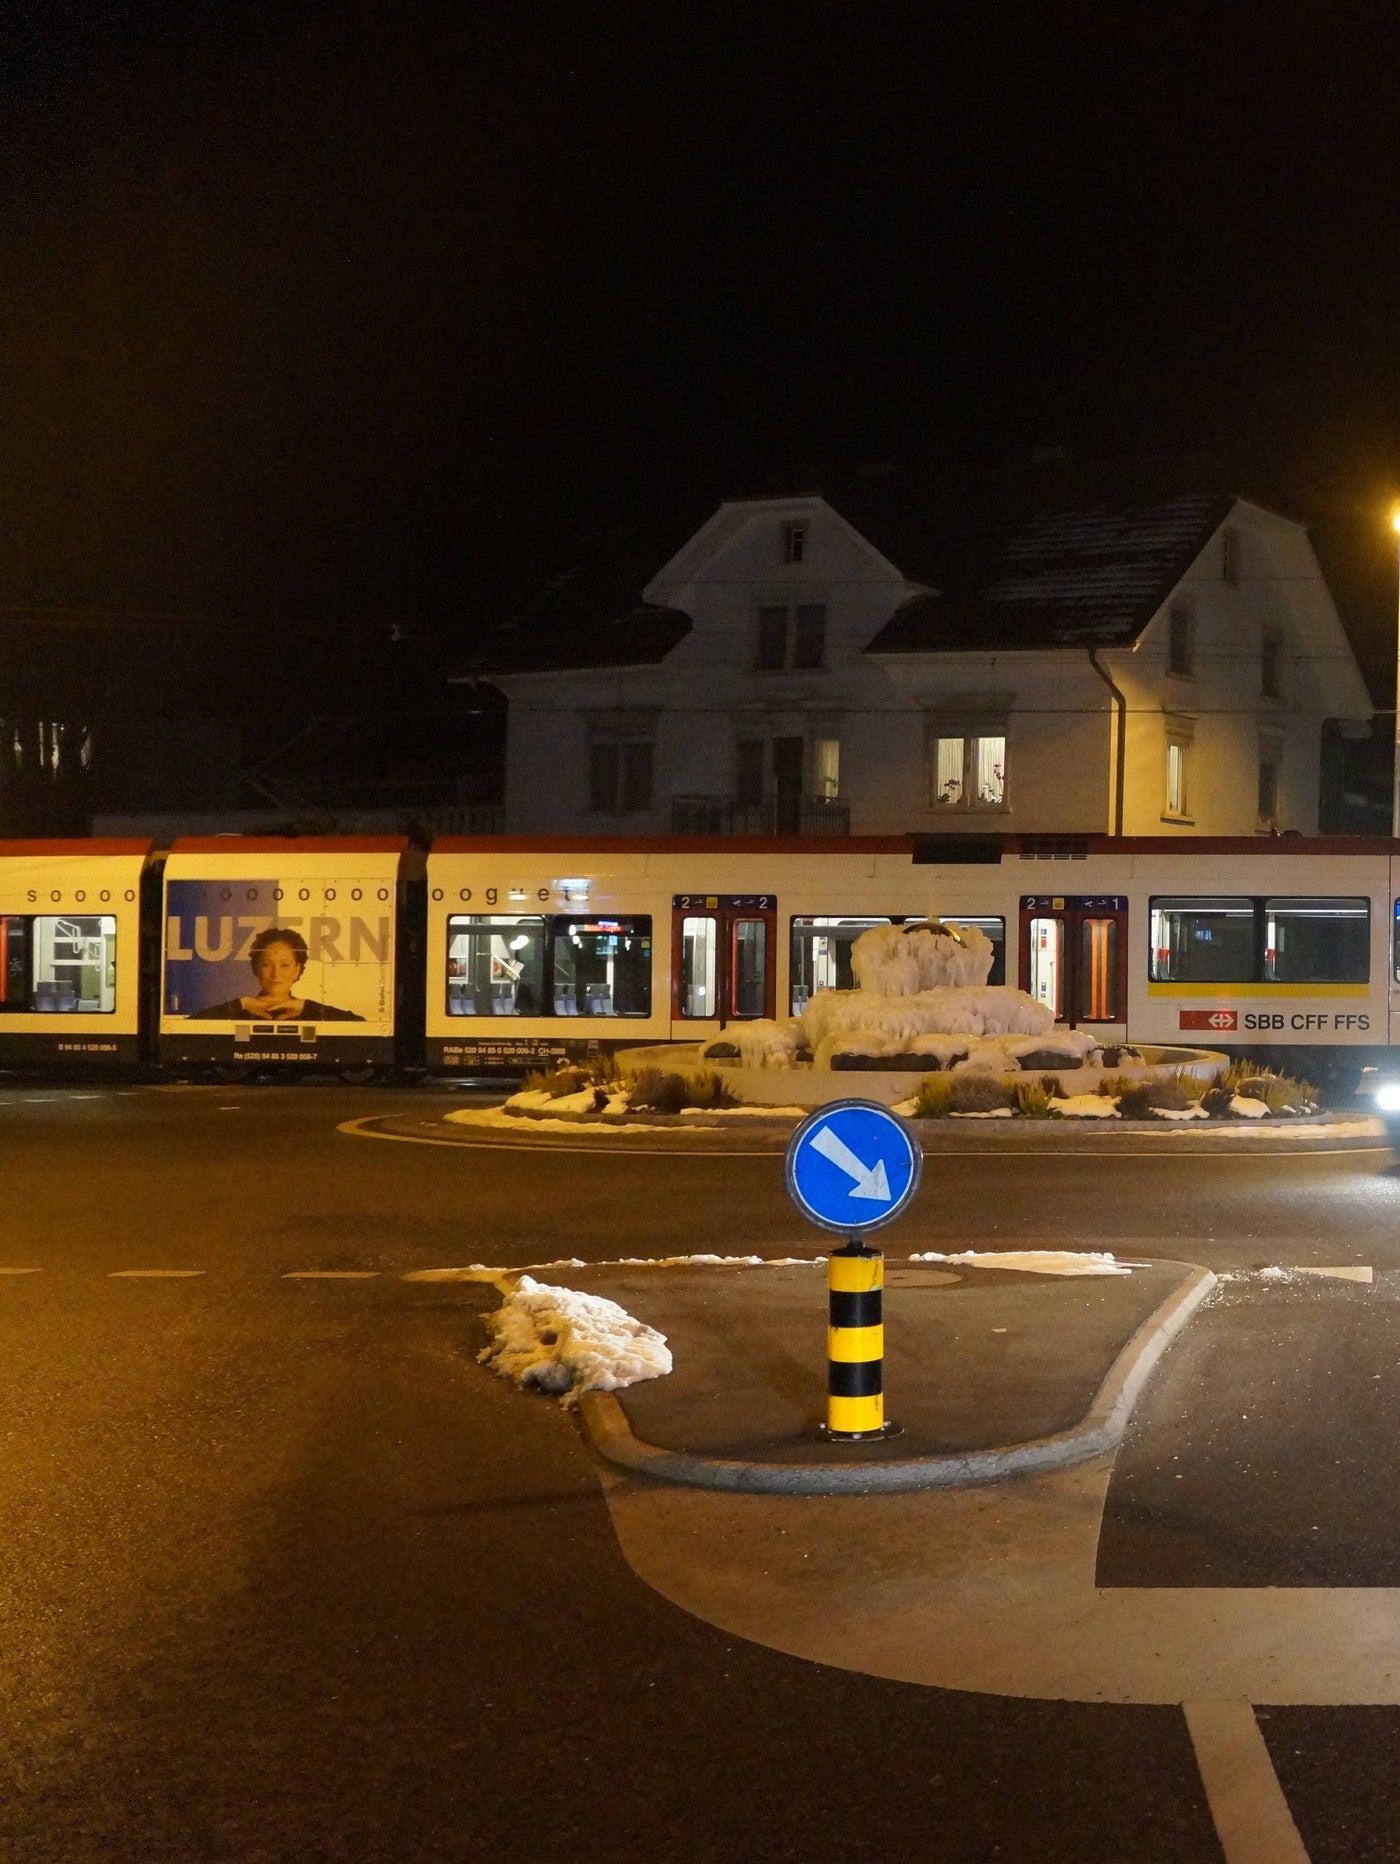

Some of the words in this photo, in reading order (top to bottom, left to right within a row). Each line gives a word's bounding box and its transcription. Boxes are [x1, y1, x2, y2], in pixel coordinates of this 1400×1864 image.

[681, 896, 690, 909] 2
[759, 896, 768, 909] 2
[1027, 898, 1036, 910] 2
[1112, 898, 1119, 910] 1
[1244, 1013, 1285, 1030] SBB
[1290, 1014, 1329, 1030] CFF
[1334, 1014, 1370, 1030] FFS
